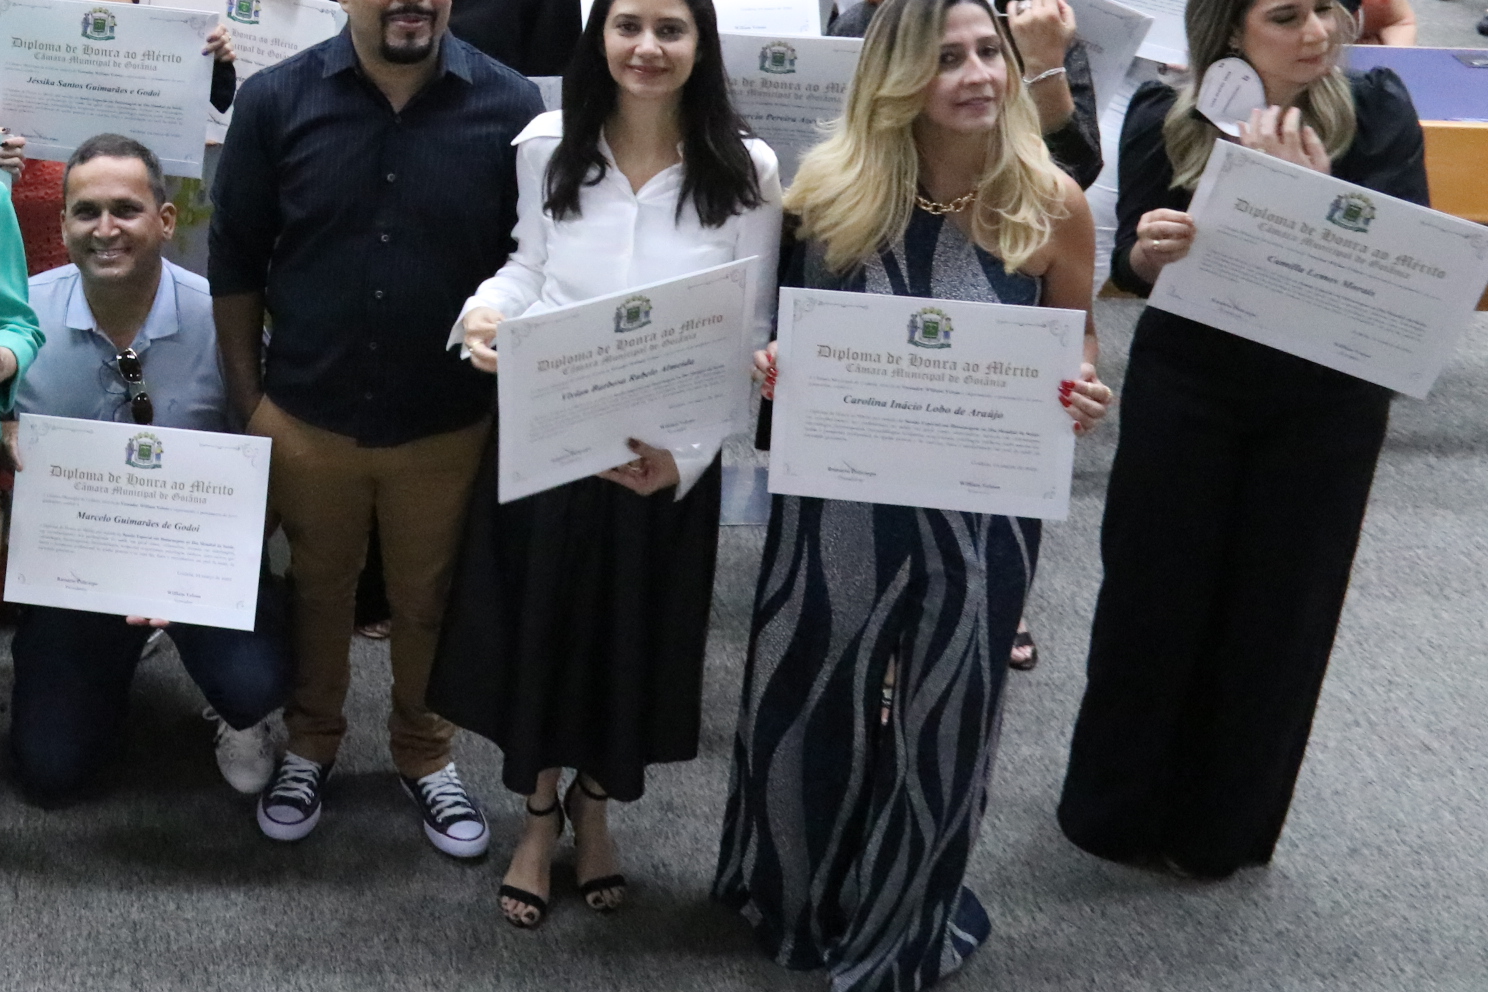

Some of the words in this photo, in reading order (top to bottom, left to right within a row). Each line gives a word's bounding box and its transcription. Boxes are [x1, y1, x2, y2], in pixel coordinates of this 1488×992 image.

[12, 37, 62, 53] Diploma
[66, 44, 77, 54] de
[83, 44, 120, 58] Honra
[124, 50, 137, 60] ao
[141, 50, 182, 64] Mérito
[26, 77, 55, 86] Jéssika
[57, 80, 83, 89] Santos
[85, 83, 128, 94] Guimarães
[137, 88, 160, 97] Godoi
[816, 345, 881, 364] Diploma
[886, 352, 902, 364] de
[908, 353, 957, 370] Honra
[963, 360, 980, 372] ao
[984, 360, 1039, 378] Mérito
[843, 395, 887, 408] Carolina
[890, 399, 923, 411] Inácio
[926, 403, 951, 414] Lobo
[954, 406, 966, 416] de
[50, 464, 104, 482] Diploma
[108, 473, 121, 484] de
[126, 473, 166, 489] Honra
[171, 480, 185, 490] ao
[189, 481, 234, 495] Mérito
[76, 511, 111, 523] Marcelo
[114, 515, 160, 528] Guimarães
[162, 521, 172, 529] de
[174, 522, 200, 532] Godoi
